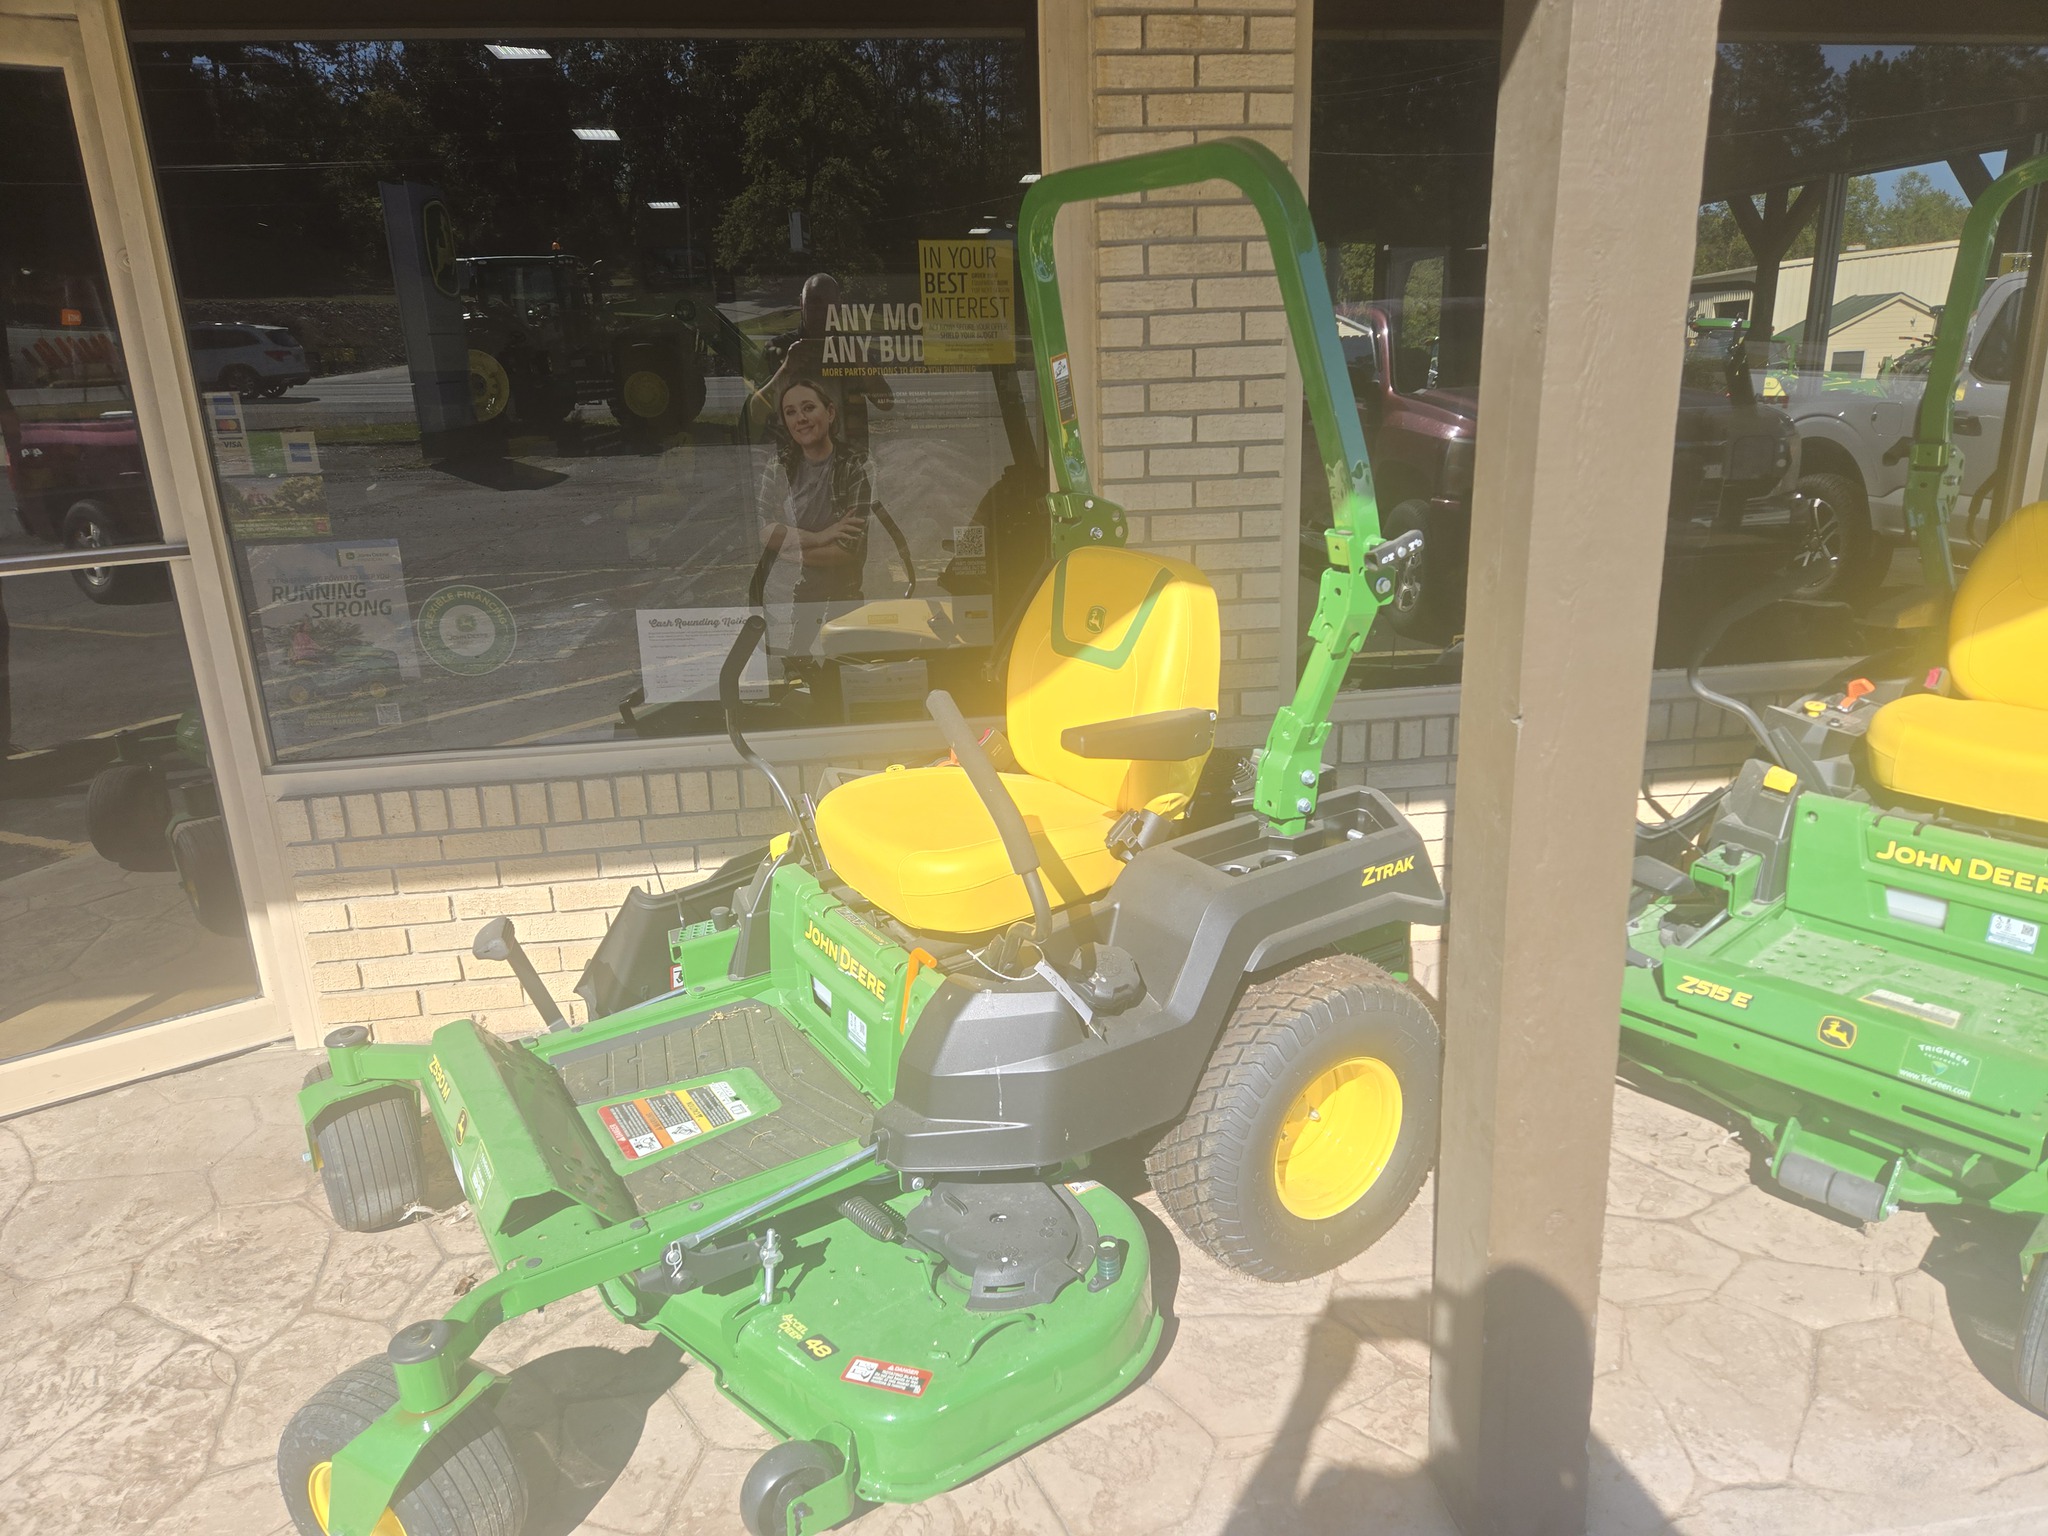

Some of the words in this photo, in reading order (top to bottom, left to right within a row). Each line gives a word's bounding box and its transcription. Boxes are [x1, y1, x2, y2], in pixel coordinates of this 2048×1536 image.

[923, 247, 941, 269] IN
[948, 246, 997, 269] YOUR
[924, 272, 968, 294] BEST
[825, 303, 875, 332] ANY
[925, 296, 1010, 319] INTEREST
[822, 335, 874, 364] ANY
[880, 335, 924, 363] BUD
[822, 368, 843, 376] MORE
[844, 367, 866, 376] PARTS
[223, 440, 242, 449] VISA
[271, 582, 367, 603] RUNNING
[311, 600, 392, 619] STRONG
[456, 591, 507, 625] FINANCING
[648, 618, 673, 628] Cash
[674, 617, 721, 629] Rounding
[721, 617, 748, 626] Notic
[1361, 855, 1415, 887] ZTRAK
[1876, 840, 1962, 876] JOHN
[1968, 858, 2048, 895] DEER
[804, 919, 839, 963] JOHN
[839, 944, 887, 1003] DEERE
[1676, 975, 1733, 1002] Z515
[1731, 991, 1754, 1009] E
[1917, 1044, 1970, 1067] TRIGREEN
[428, 1053, 445, 1090] Z530
[440, 1084, 451, 1103] M
[1899, 1068, 1971, 1098] www.TriGreen.com
[778, 1321, 804, 1341] DEEP
[781, 1313, 808, 1335] ACCEL
[805, 1338, 833, 1358] 48
[894, 1366, 919, 1375] DANGER
